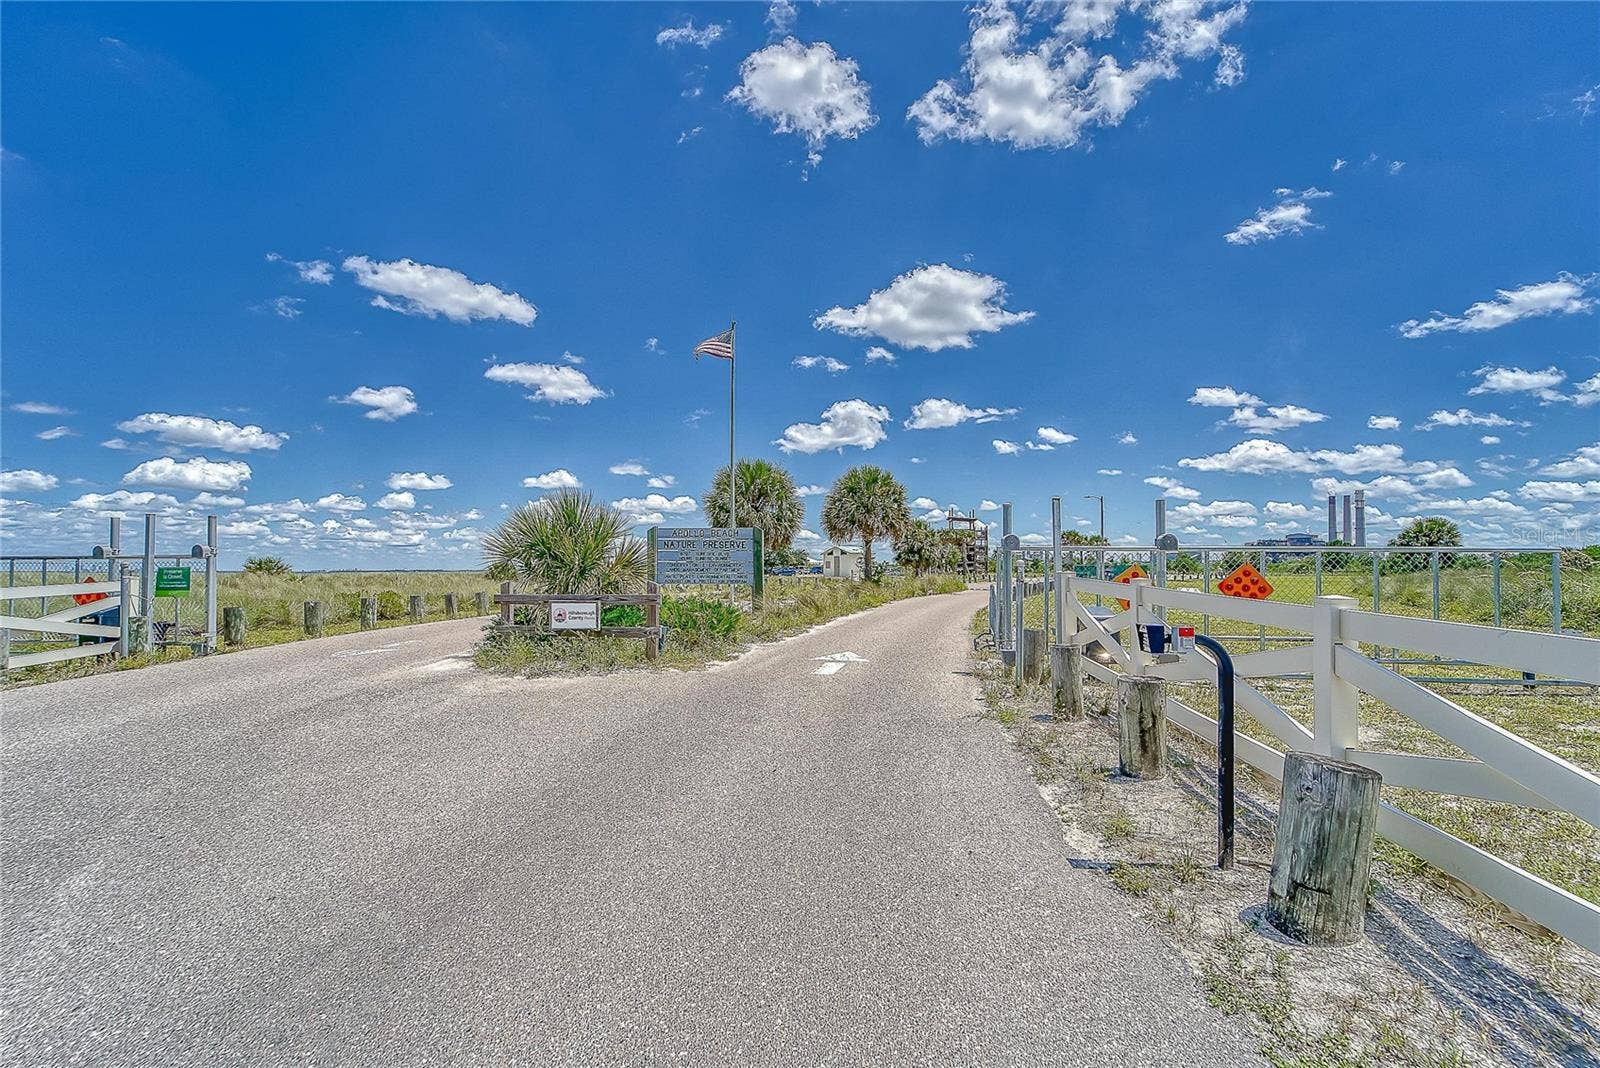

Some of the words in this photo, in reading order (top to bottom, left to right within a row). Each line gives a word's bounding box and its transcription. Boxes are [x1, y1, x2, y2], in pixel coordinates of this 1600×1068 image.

[672, 529, 705, 538] APOLLO
[710, 529, 739, 538] BEACH
[663, 540, 697, 549] NATURE
[702, 540, 747, 549] PRESERVE
